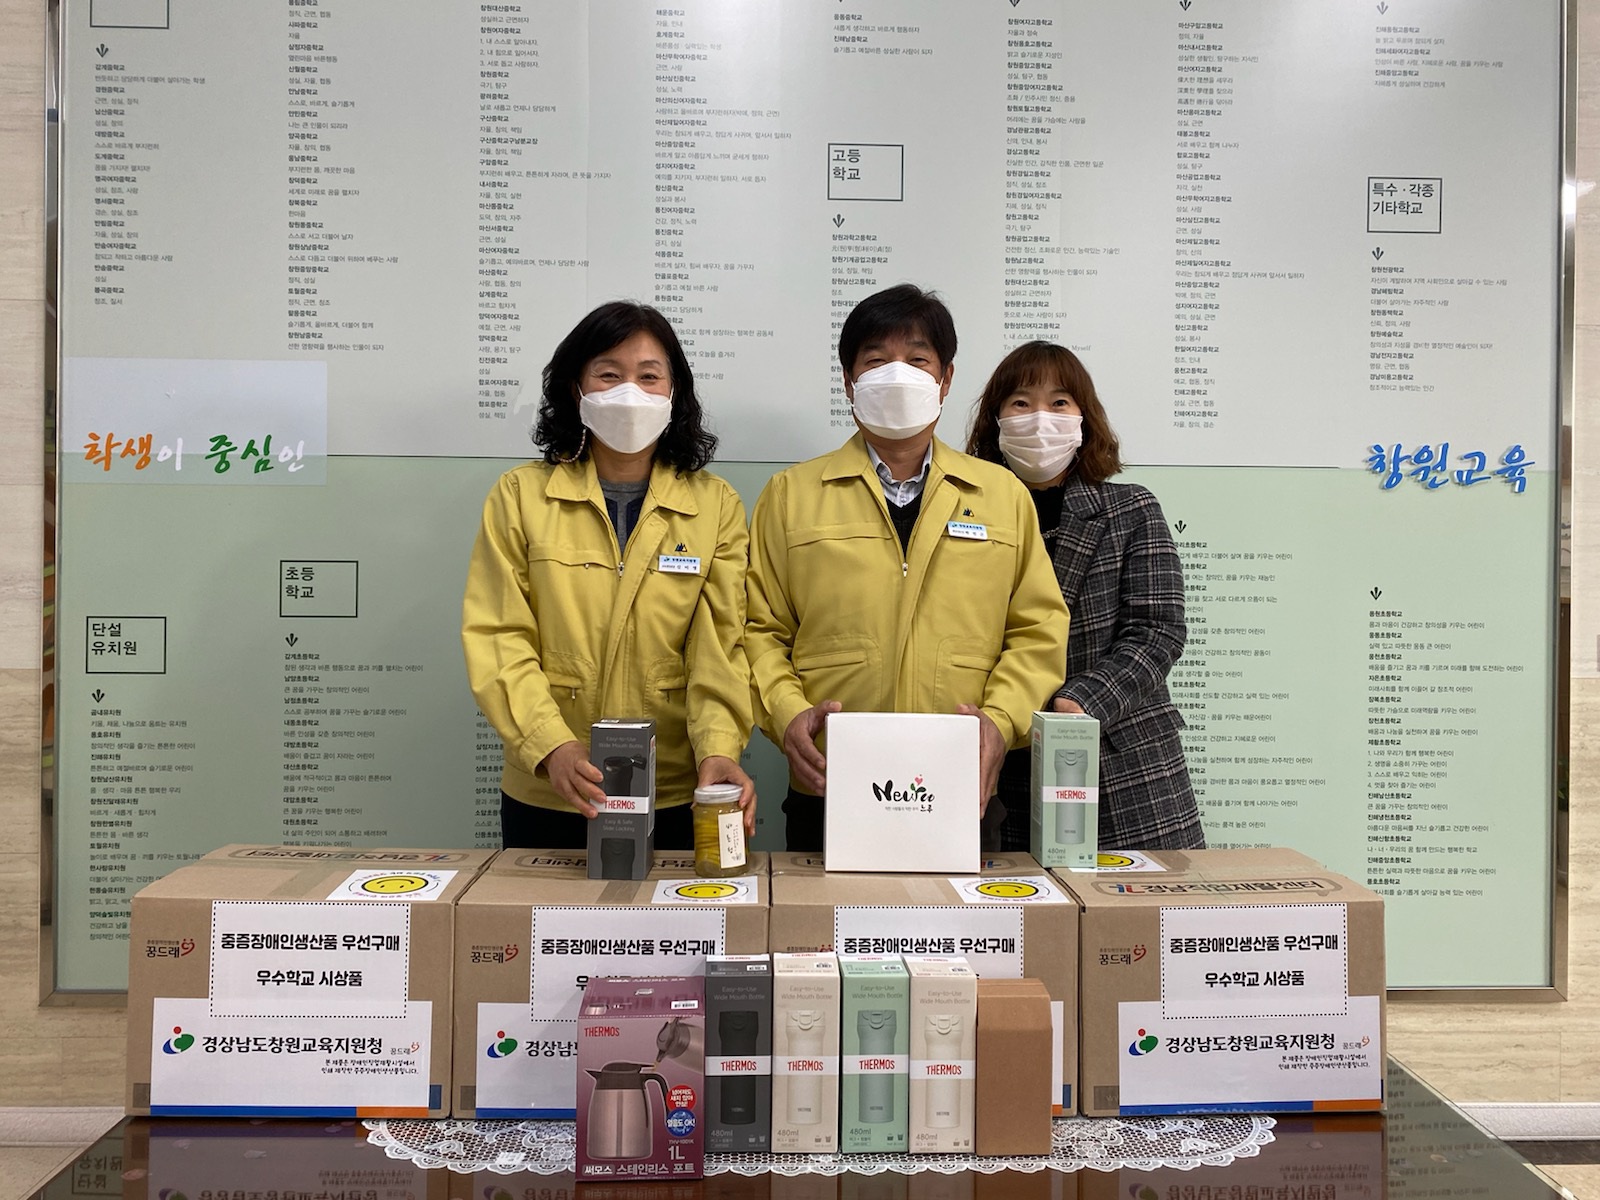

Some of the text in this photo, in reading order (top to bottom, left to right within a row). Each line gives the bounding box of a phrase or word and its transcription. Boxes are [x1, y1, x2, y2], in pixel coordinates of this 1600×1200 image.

[832, 149, 861, 163] 고등
[832, 166, 861, 181] 학교
[1372, 183, 1434, 197] 특수 각종
[1372, 201, 1422, 215] 기타학교
[84, 432, 304, 473] 학생이 중심인
[1368, 442, 1536, 493] 창원교육
[285, 567, 314, 581] 초등
[285, 585, 314, 599] 학교
[92, 623, 121, 637] 단설
[91, 641, 137, 655] 유치원
[1056, 791, 1086, 799] THERMOS
[604, 801, 635, 809] THERMOS
[221, 934, 400, 951] 중증장애인생산품 우선구매
[541, 939, 715, 955] 중증장애인생산품 우선구매
[844, 938, 1015, 954] 중증장애인생산품 우선구매
[1170, 935, 1338, 954] 중증장애인생산품 우선구매
[146, 944, 180, 958] 꿈드래
[470, 952, 503, 963] 꿈드래
[1099, 953, 1131, 965] 꿈드래
[257, 971, 362, 986] 우수학교 시상품
[1205, 971, 1305, 987] 우수학교 시상품
[860, 984, 895, 992] Easy-to-Use
[782, 992, 832, 1000] Wide Mouth Bottle
[584, 1027, 620, 1037] THERMOS
[202, 1036, 382, 1054] 경상남도창원교육지원청
[1165, 1034, 1335, 1053] 경상남도창원교육지원청
[721, 1061, 756, 1071] THERMOS
[787, 1061, 823, 1071] THERMOS
[859, 1059, 895, 1070] THERMOS
[926, 1064, 962, 1075] THERMOS
[777, 1129, 799, 1137] 480ml
[668, 1147, 685, 1160] 1L
[584, 1163, 695, 1175] 써모스 스테인리스 포트
